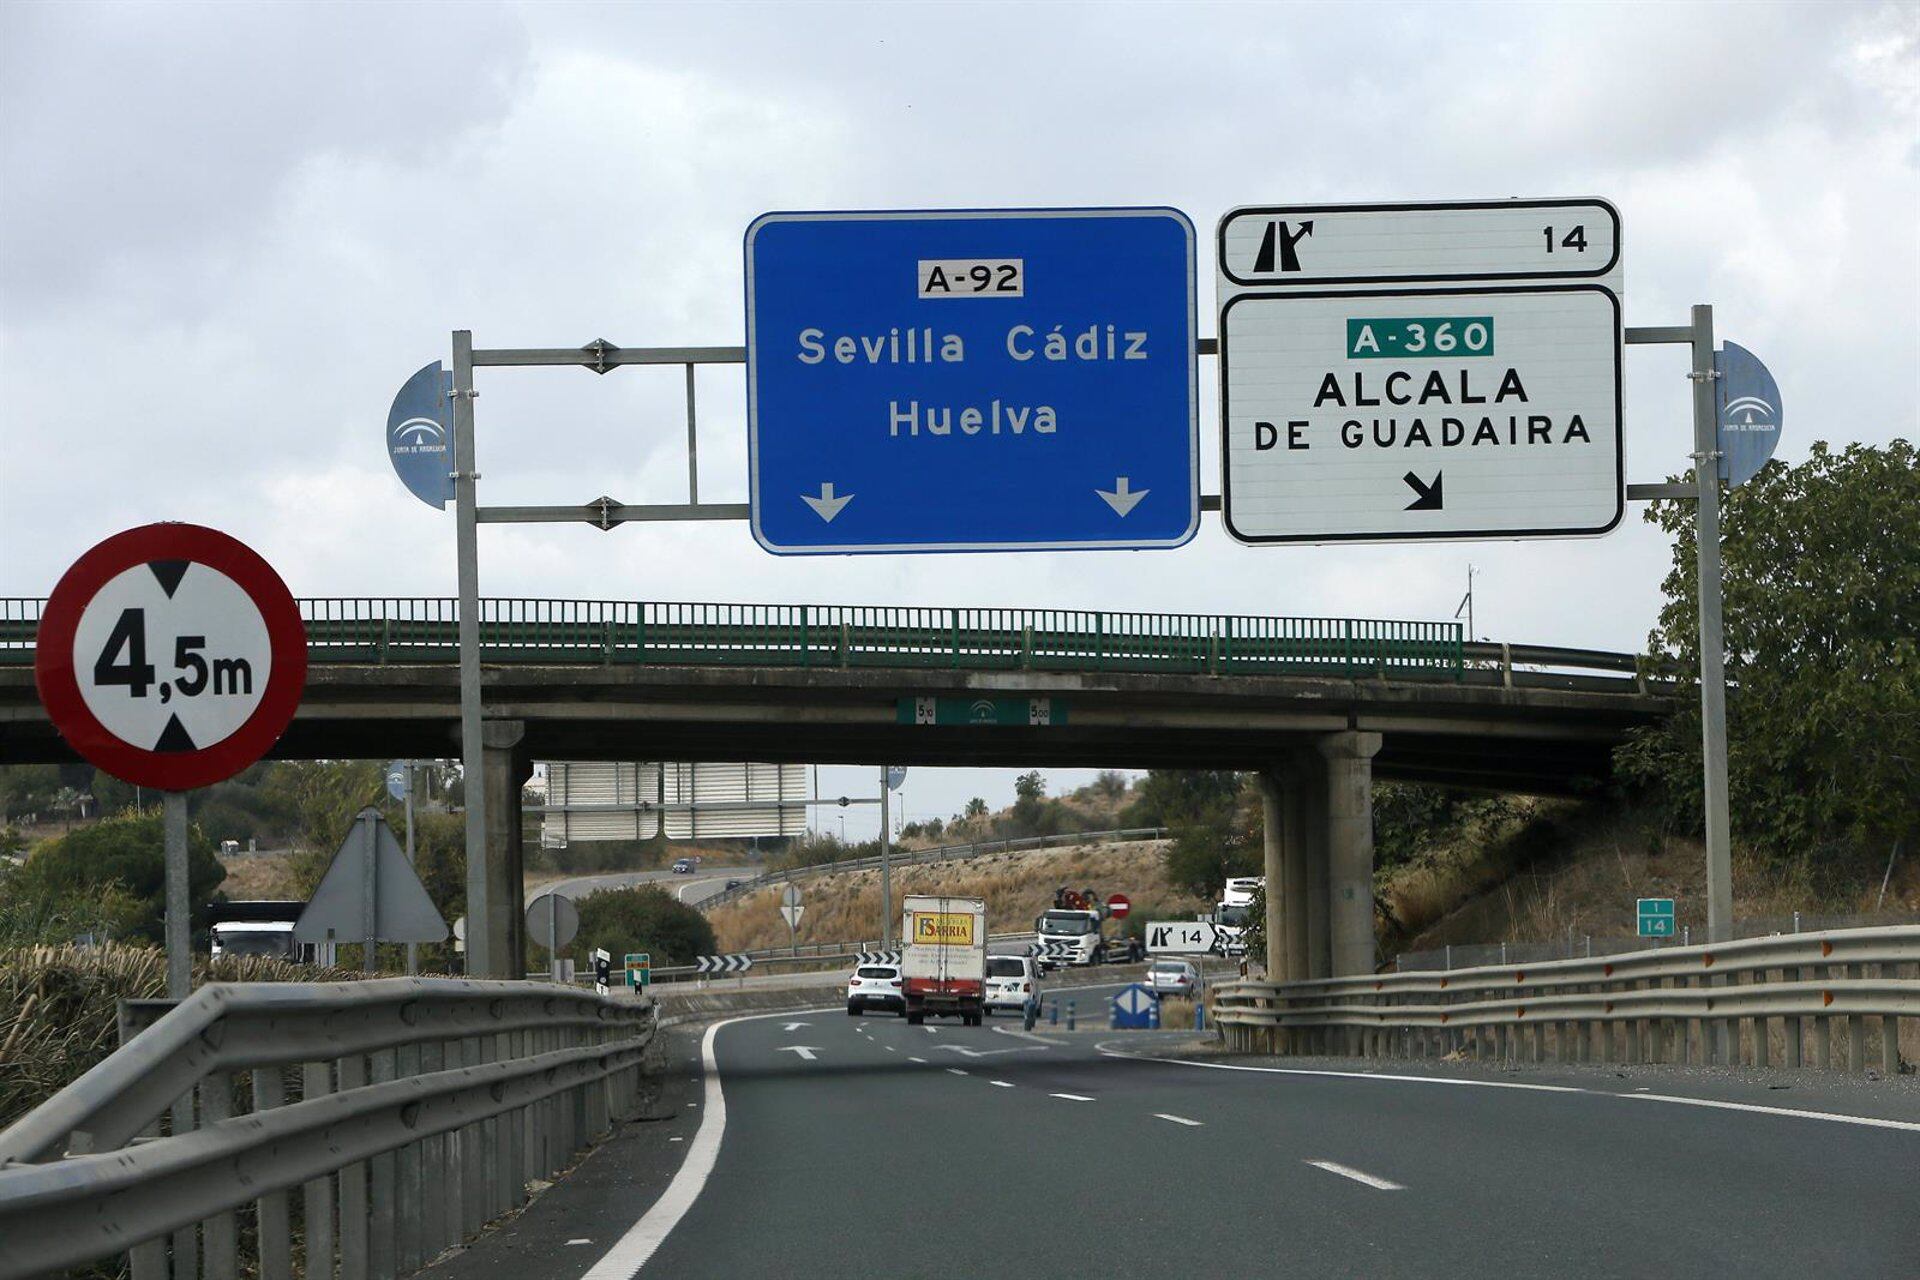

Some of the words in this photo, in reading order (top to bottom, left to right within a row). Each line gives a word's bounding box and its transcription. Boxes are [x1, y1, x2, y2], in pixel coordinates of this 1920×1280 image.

[1543, 225, 1588, 253] 14
[924, 264, 1018, 293] A-92
[797, 327, 964, 364] Sevilla
[1006, 324, 1148, 361] Cádiz
[1353, 322, 1488, 353] A-360
[1313, 368, 1529, 408] ALCALA
[889, 400, 1057, 436] Huelva
[1255, 421, 1310, 450] DE
[1341, 414, 1591, 450] GUADAIRA
[1182, 930, 1202, 944] 14
[1647, 920, 1666, 933] 14
